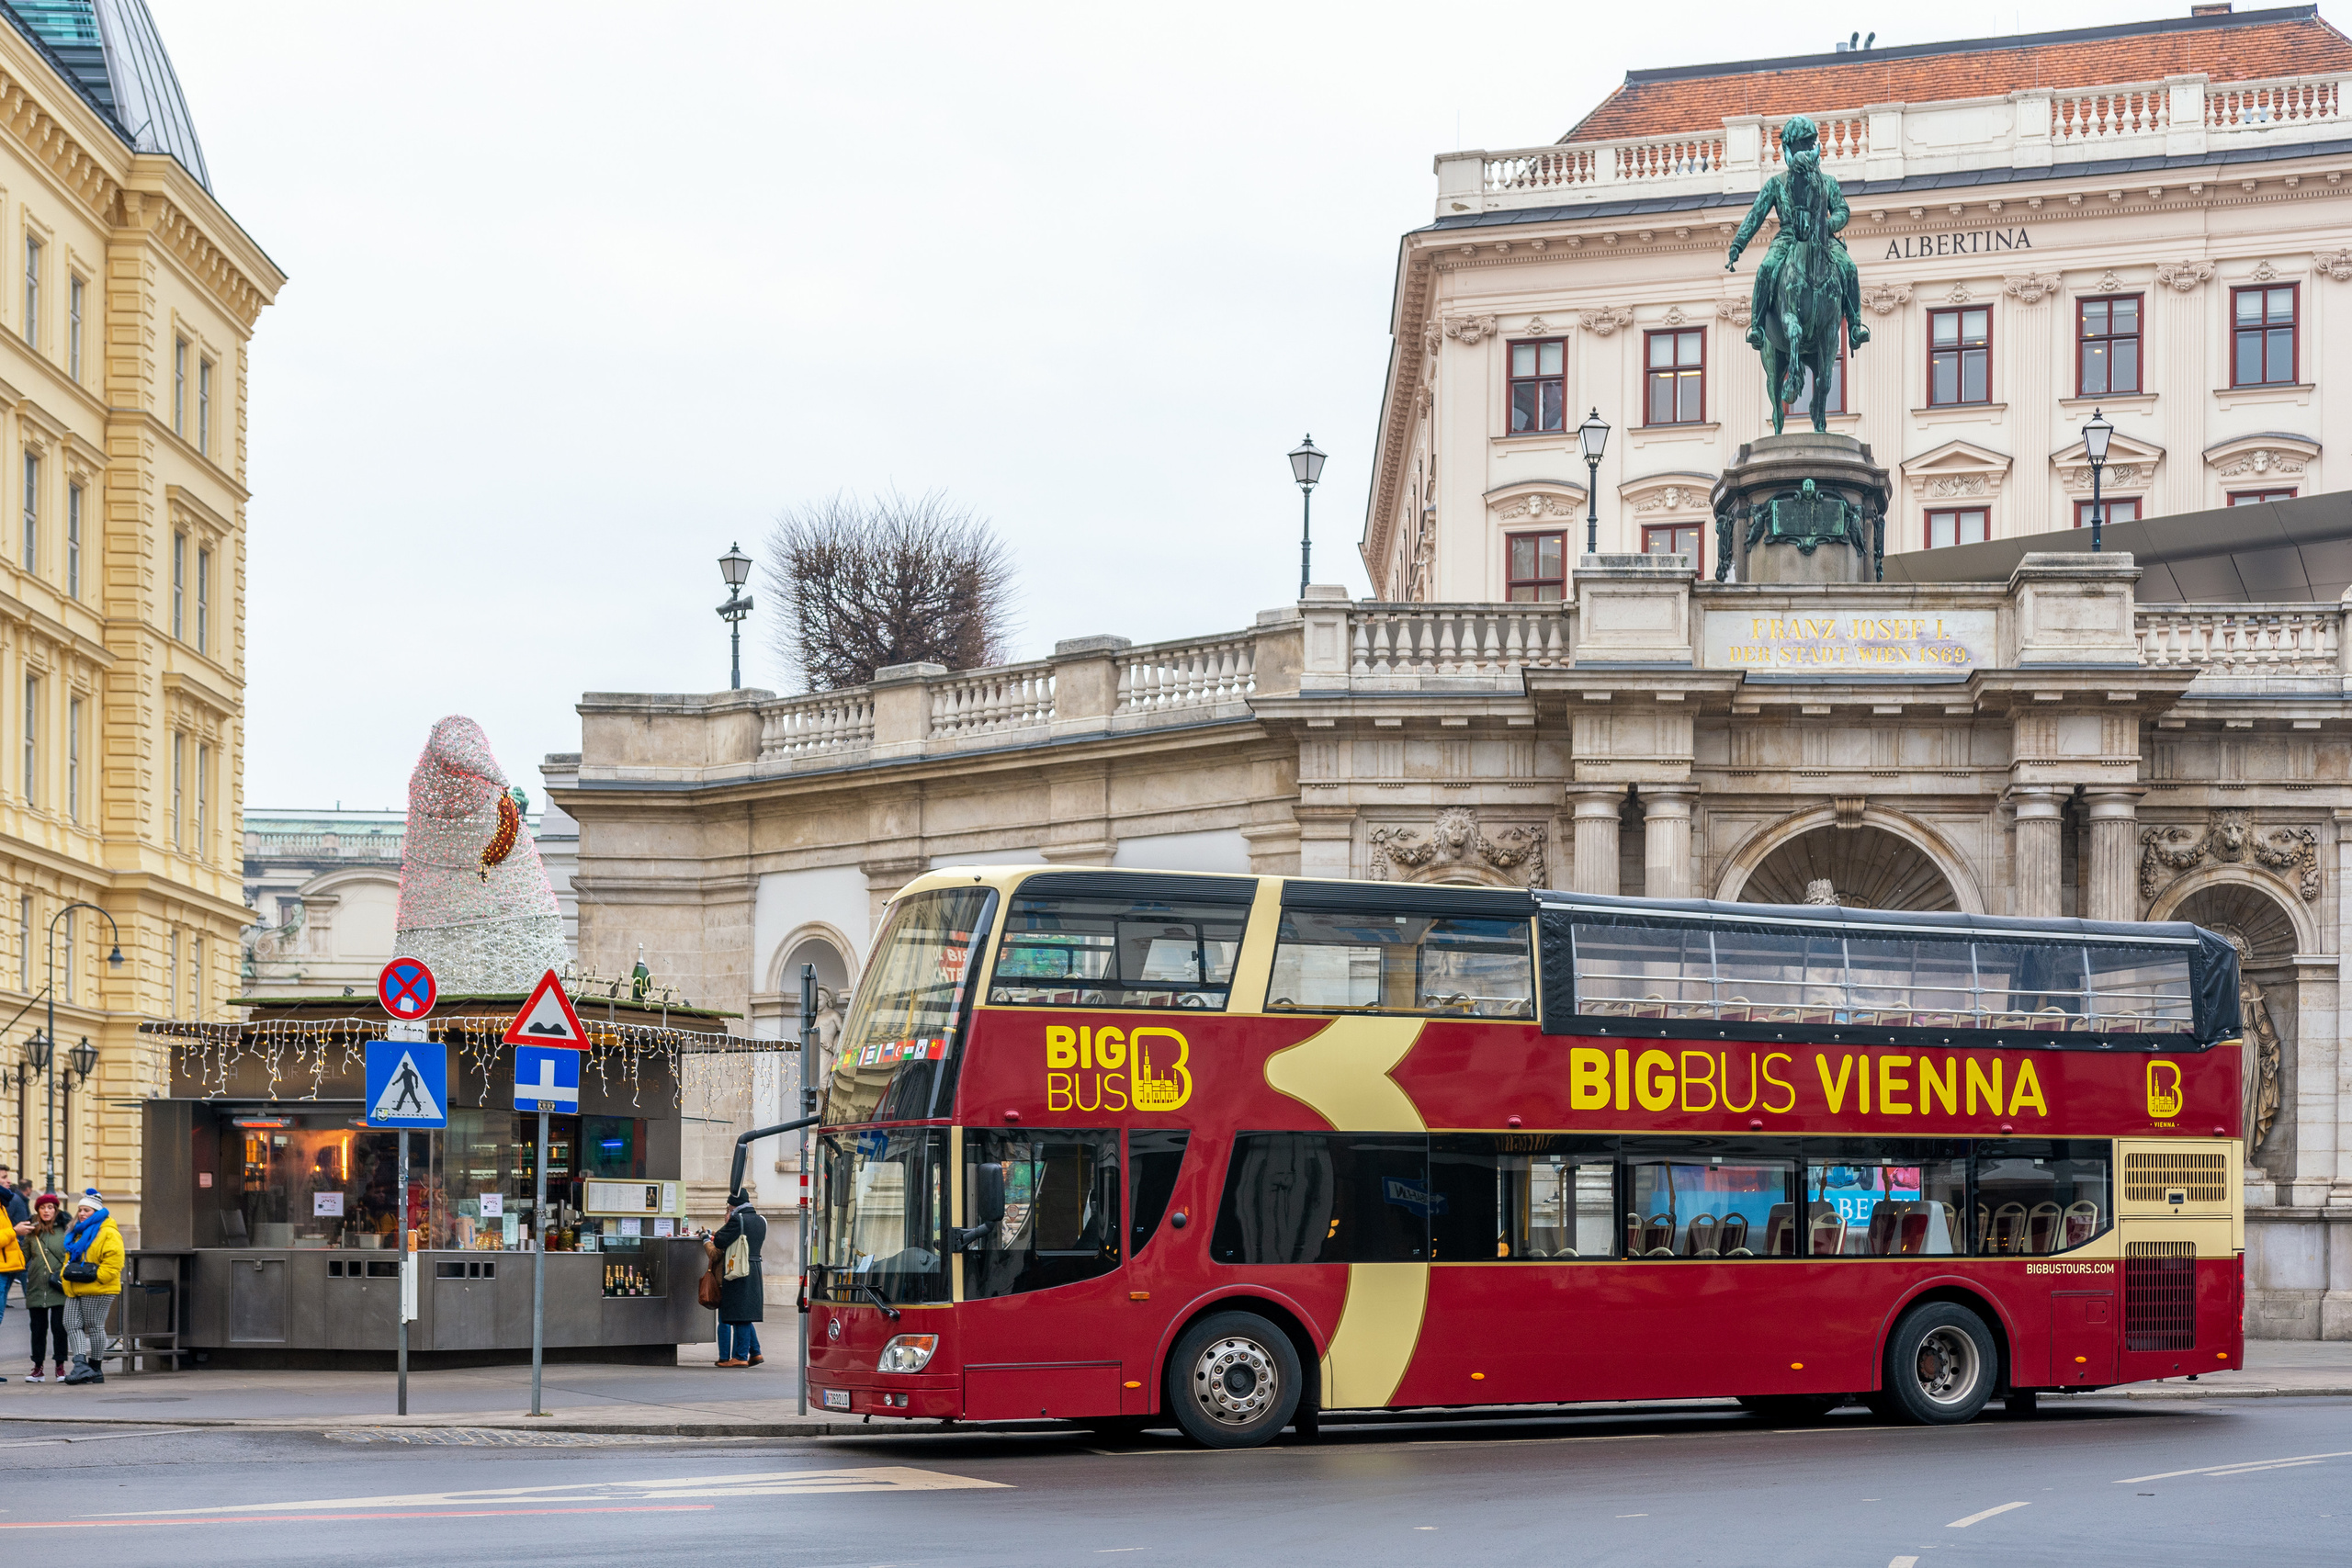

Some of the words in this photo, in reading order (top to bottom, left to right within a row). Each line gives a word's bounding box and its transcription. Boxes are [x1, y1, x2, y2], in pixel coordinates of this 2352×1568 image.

[1885, 227, 2032, 260] ALBERTINA
[1752, 619, 1837, 640] FRANZ
[1847, 619, 1926, 640] JOSEF
[1936, 619, 1950, 639] I.
[1728, 647, 1770, 662] DER
[1780, 647, 1849, 662] STADT
[1858, 647, 1911, 662] WIEN
[1918, 647, 1972, 663] 1869.
[1046, 1025, 1126, 1069] BIG
[1046, 1072, 1128, 1112] BUS
[1815, 1053, 2048, 1117] VIENNA
[2026, 1263, 2115, 1274] BIGBUSTOURS.COM
